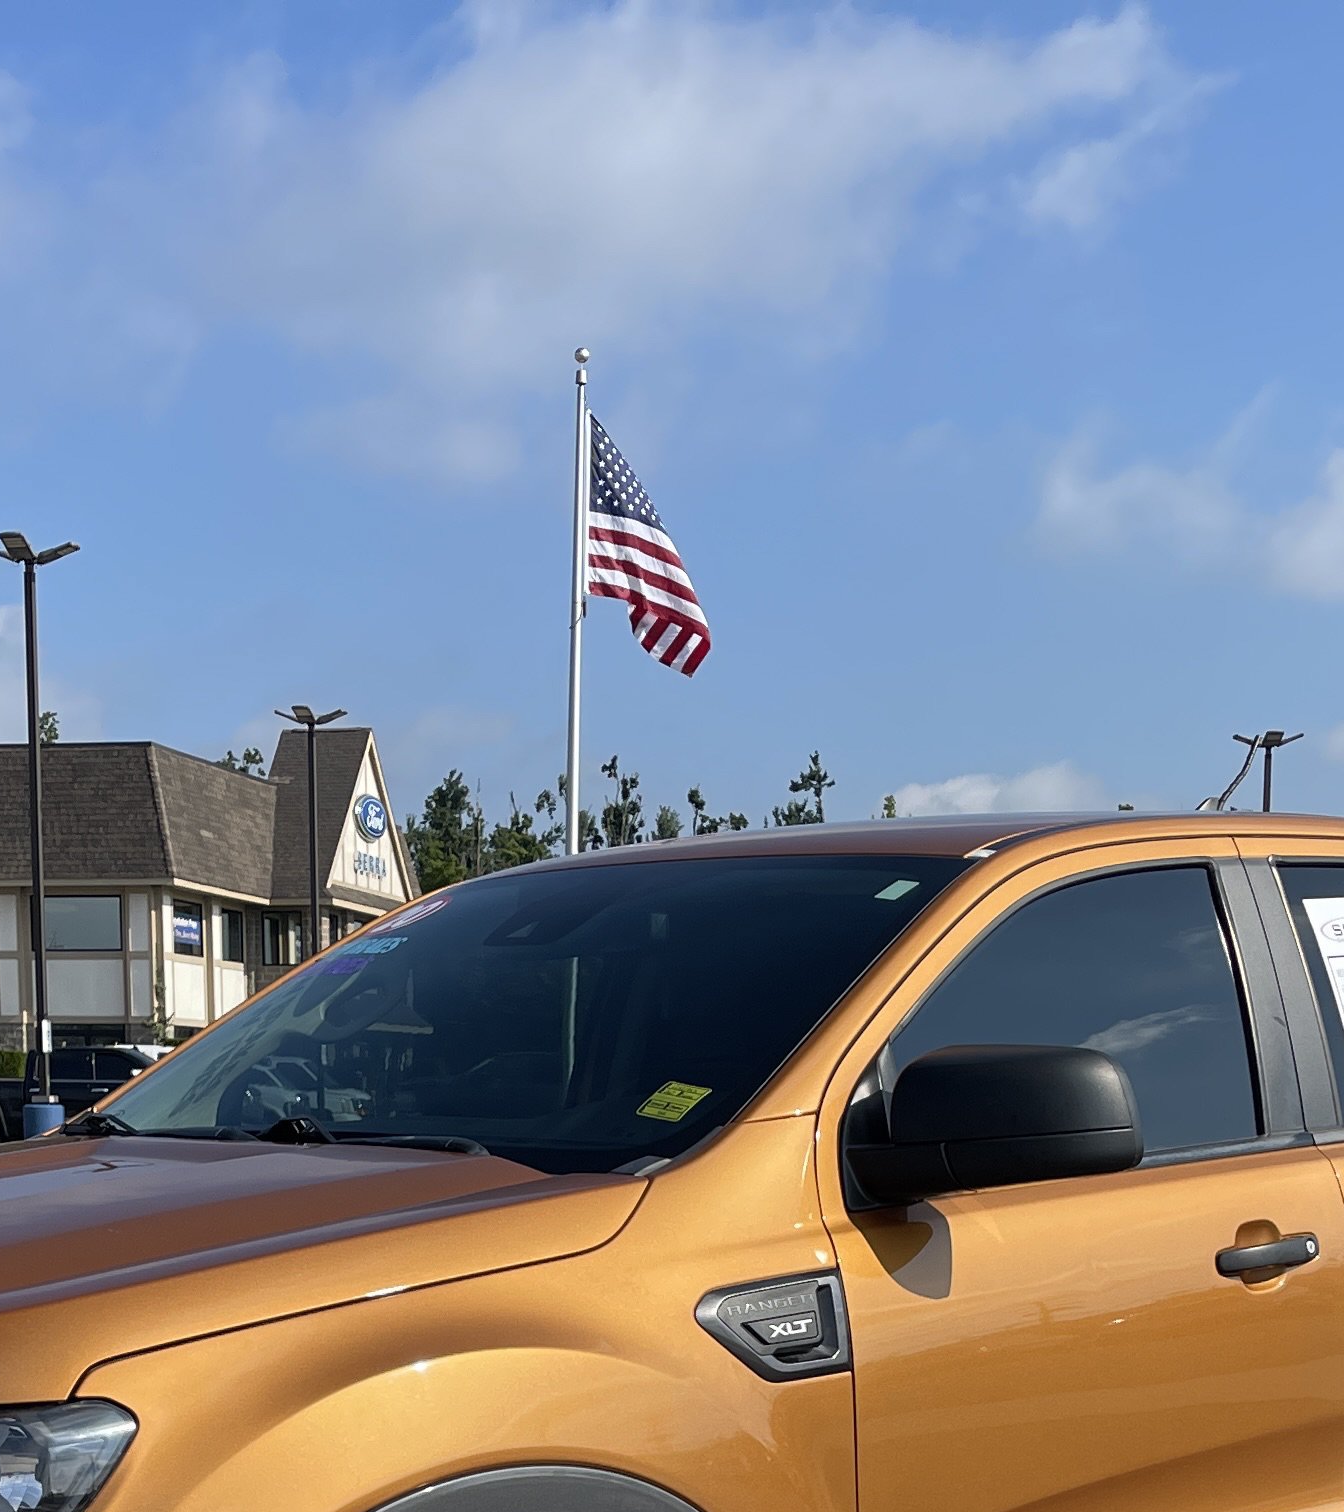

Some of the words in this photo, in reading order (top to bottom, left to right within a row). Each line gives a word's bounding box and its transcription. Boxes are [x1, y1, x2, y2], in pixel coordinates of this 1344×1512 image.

[366, 803, 385, 831] Ford
[726, 1293, 816, 1317] RANGER
[768, 1318, 813, 1338] XLT
